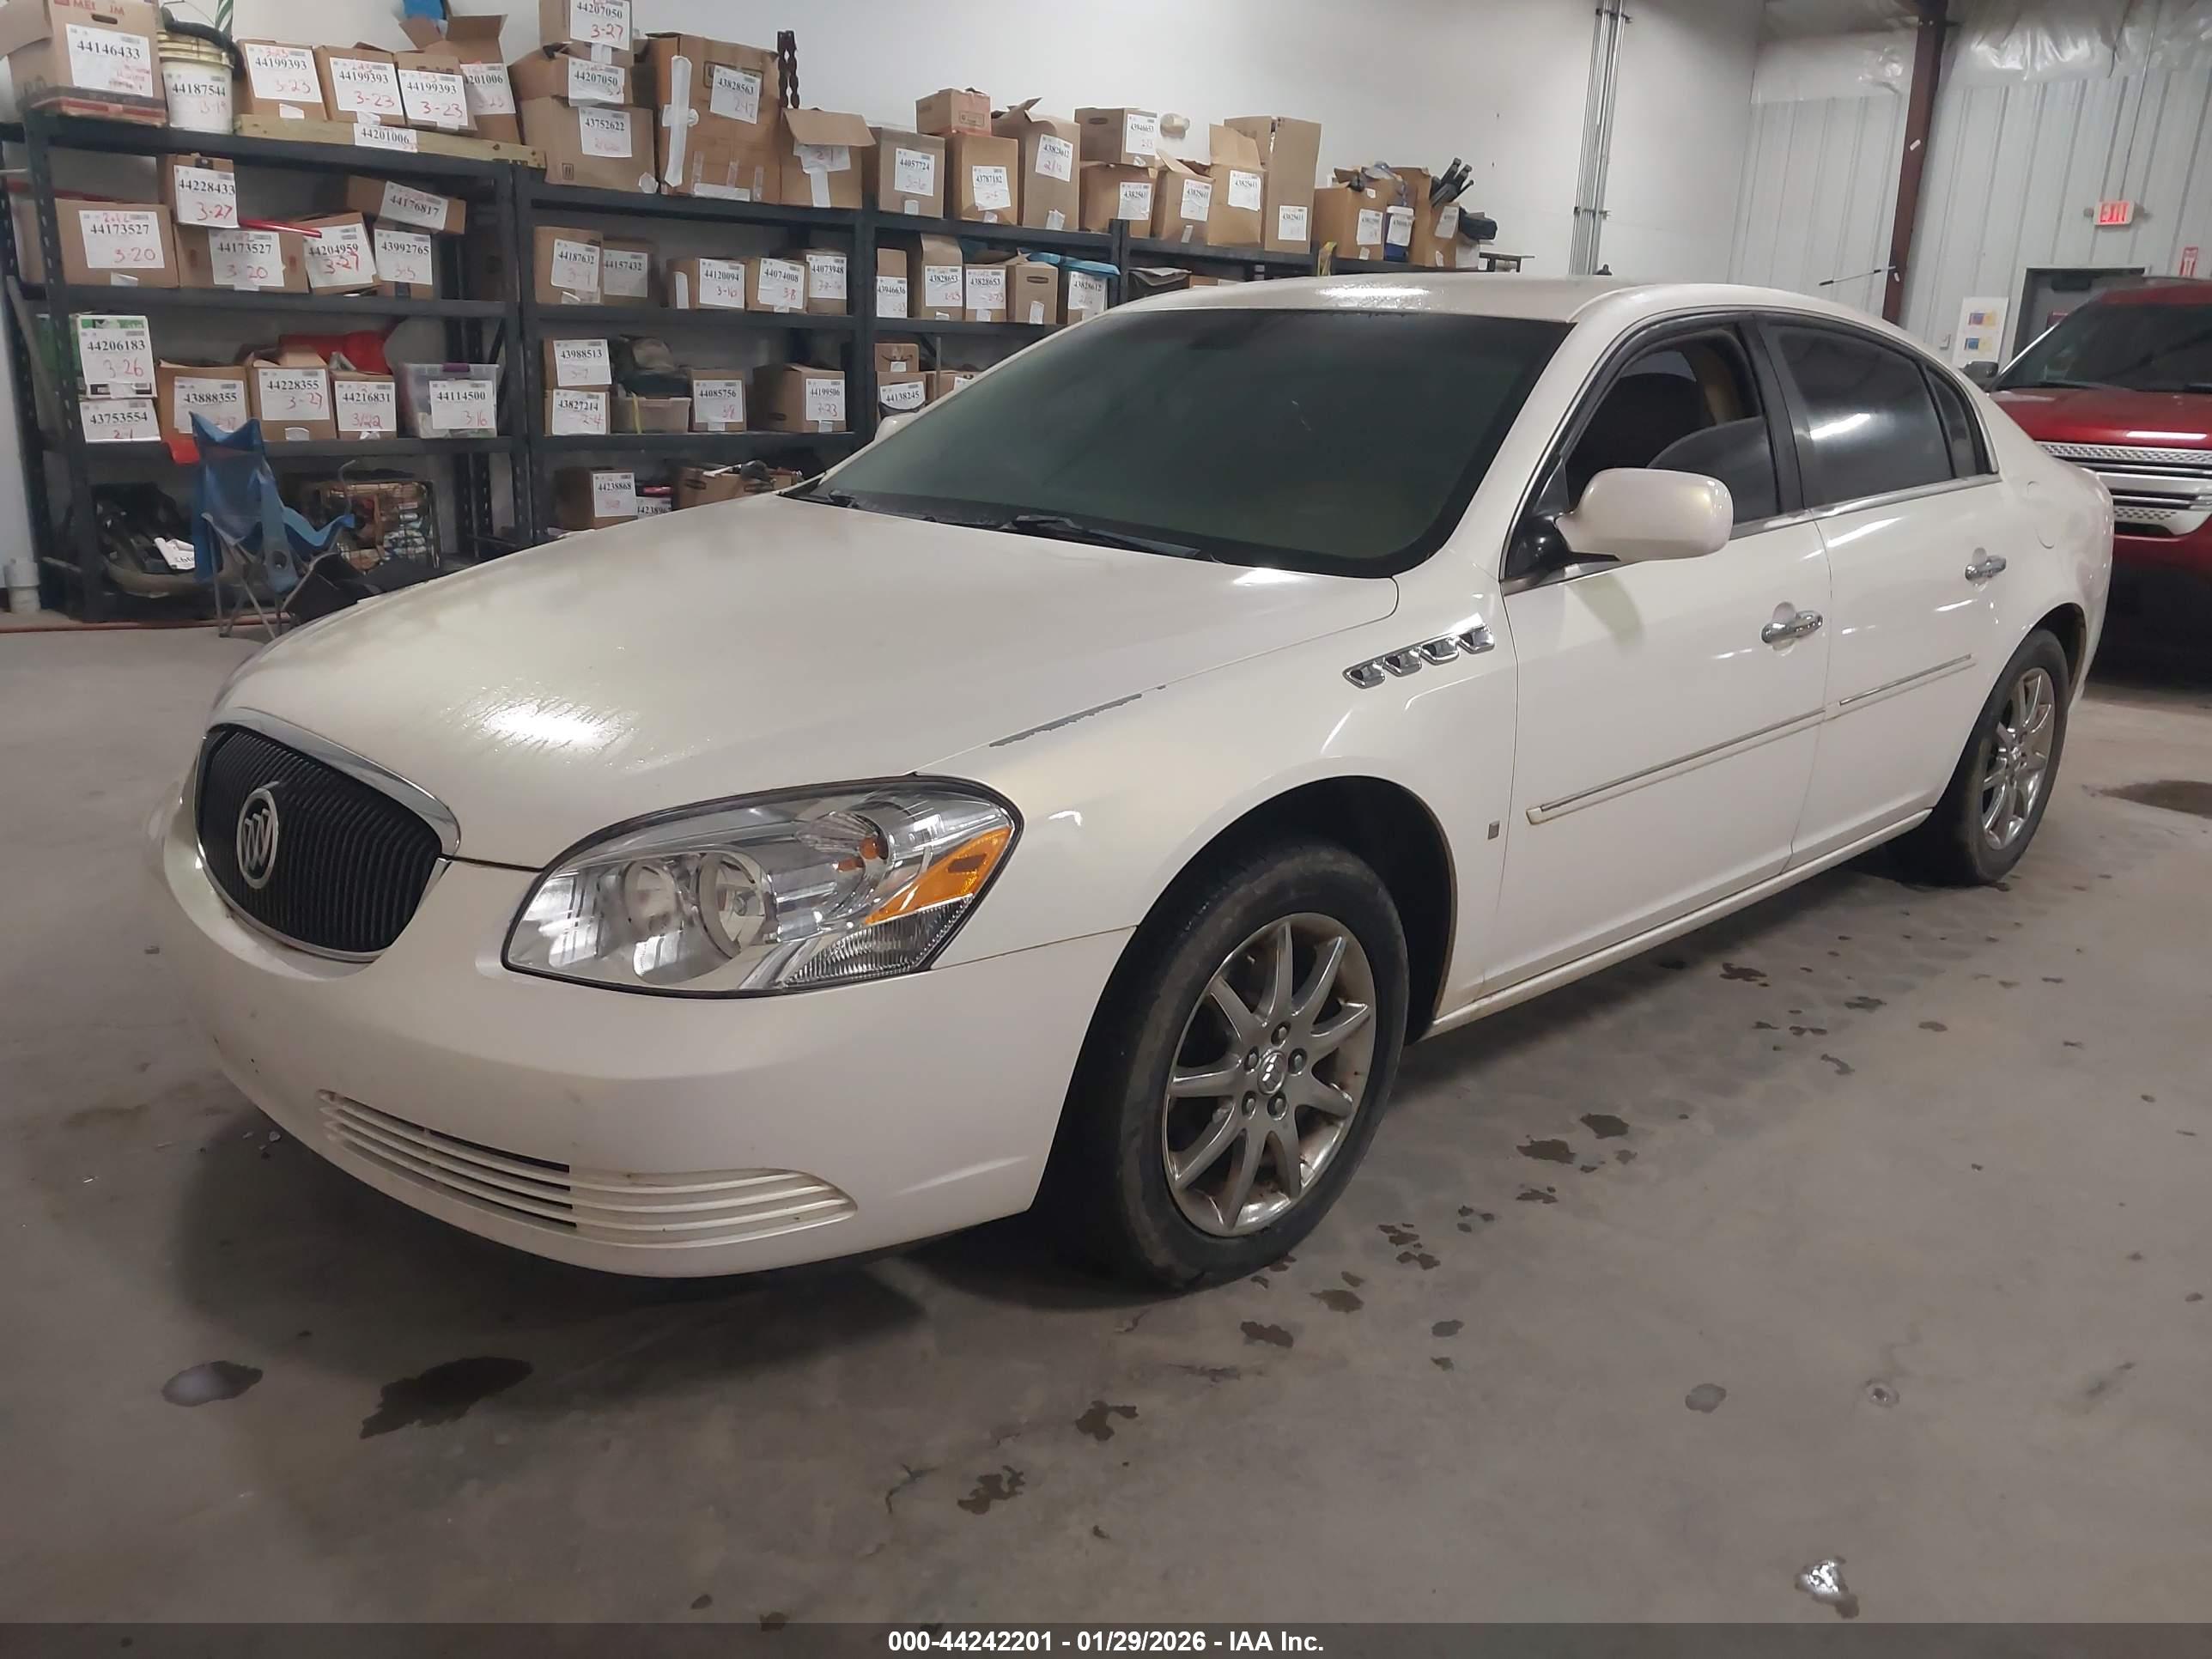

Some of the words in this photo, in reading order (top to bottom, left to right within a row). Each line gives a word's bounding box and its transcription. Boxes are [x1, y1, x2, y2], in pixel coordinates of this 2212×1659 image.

[576, 2, 623, 19] 44207050
[591, 23, 623, 41] 3-27
[77, 40, 140, 60] 44146433
[255, 57, 307, 70] 44199393
[339, 70, 389, 84] 44199393
[465, 75, 503, 84] 4201006
[574, 70, 618, 87] 44207050
[173, 82, 226, 96] 44187544
[407, 82, 458, 95] 44199393
[355, 90, 395, 108] 3-23
[421, 100, 463, 118] 3-23
[585, 118, 625, 131] 43752622
[362, 128, 410, 144] 44201006
[899, 157, 930, 172] 44057724
[179, 179, 235, 196] 44228433
[389, 193, 441, 216] 44176817
[2100, 203, 2130, 222] EXIT
[90, 223, 149, 234] 44173527
[217, 242, 271, 254] 44173527
[308, 243, 359, 257] 44204959
[381, 241, 429, 255] 43992765
[558, 251, 594, 264] 44187632
[604, 260, 642, 270] 44157432
[811, 265, 844, 274] 44073948
[704, 270, 739, 282] 44120094
[763, 270, 799, 283] 44074008
[929, 275, 959, 283] 43828653
[969, 277, 1001, 286] 43828653
[88, 339, 145, 351] 44206183
[561, 349, 603, 359] 43988513
[267, 380, 319, 391] 44228355
[184, 392, 238, 403] 43888355
[343, 392, 391, 403] 44216831
[437, 391, 486, 401] 44114500
[699, 389, 737, 398] 44085756
[810, 388, 841, 397] 44199506
[885, 390, 920, 403] 44138245
[557, 399, 599, 411] 43827214
[89, 411, 148, 425] 43753554
[599, 482, 632, 491] 44238868
